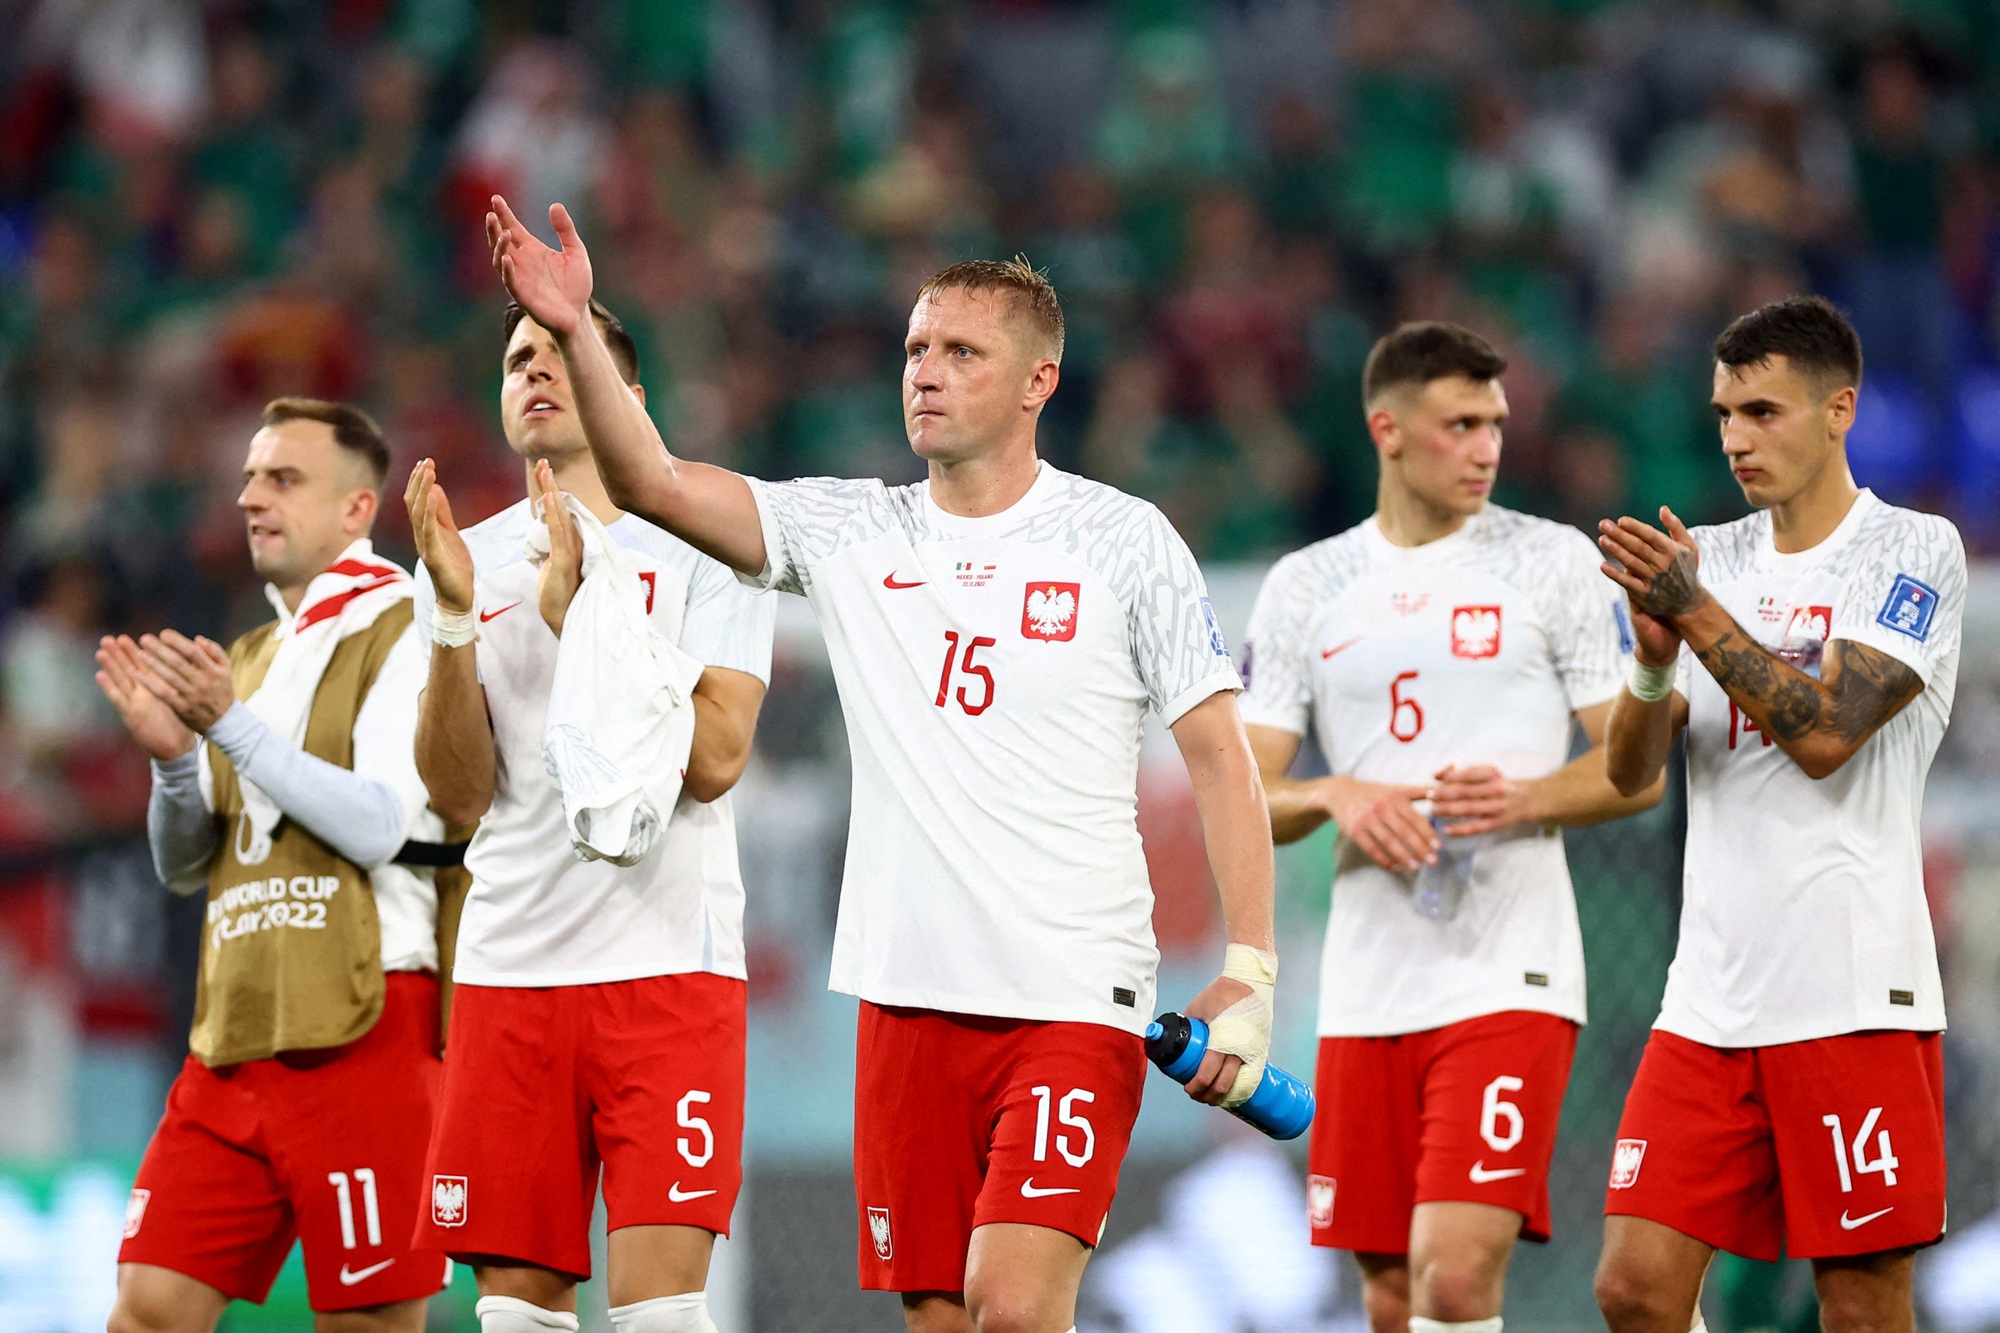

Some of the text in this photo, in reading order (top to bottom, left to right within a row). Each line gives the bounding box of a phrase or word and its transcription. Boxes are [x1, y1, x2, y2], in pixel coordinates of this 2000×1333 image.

[934, 630, 996, 717] 15
[1389, 669, 1424, 743] 6
[222, 876, 341, 910] WORLD CUP
[676, 1089, 714, 1168] 5
[1031, 1085, 1096, 1168] 15
[1480, 1075, 1524, 1152] 6
[1822, 1106, 1899, 1193] 14
[327, 1167, 382, 1250] 11
